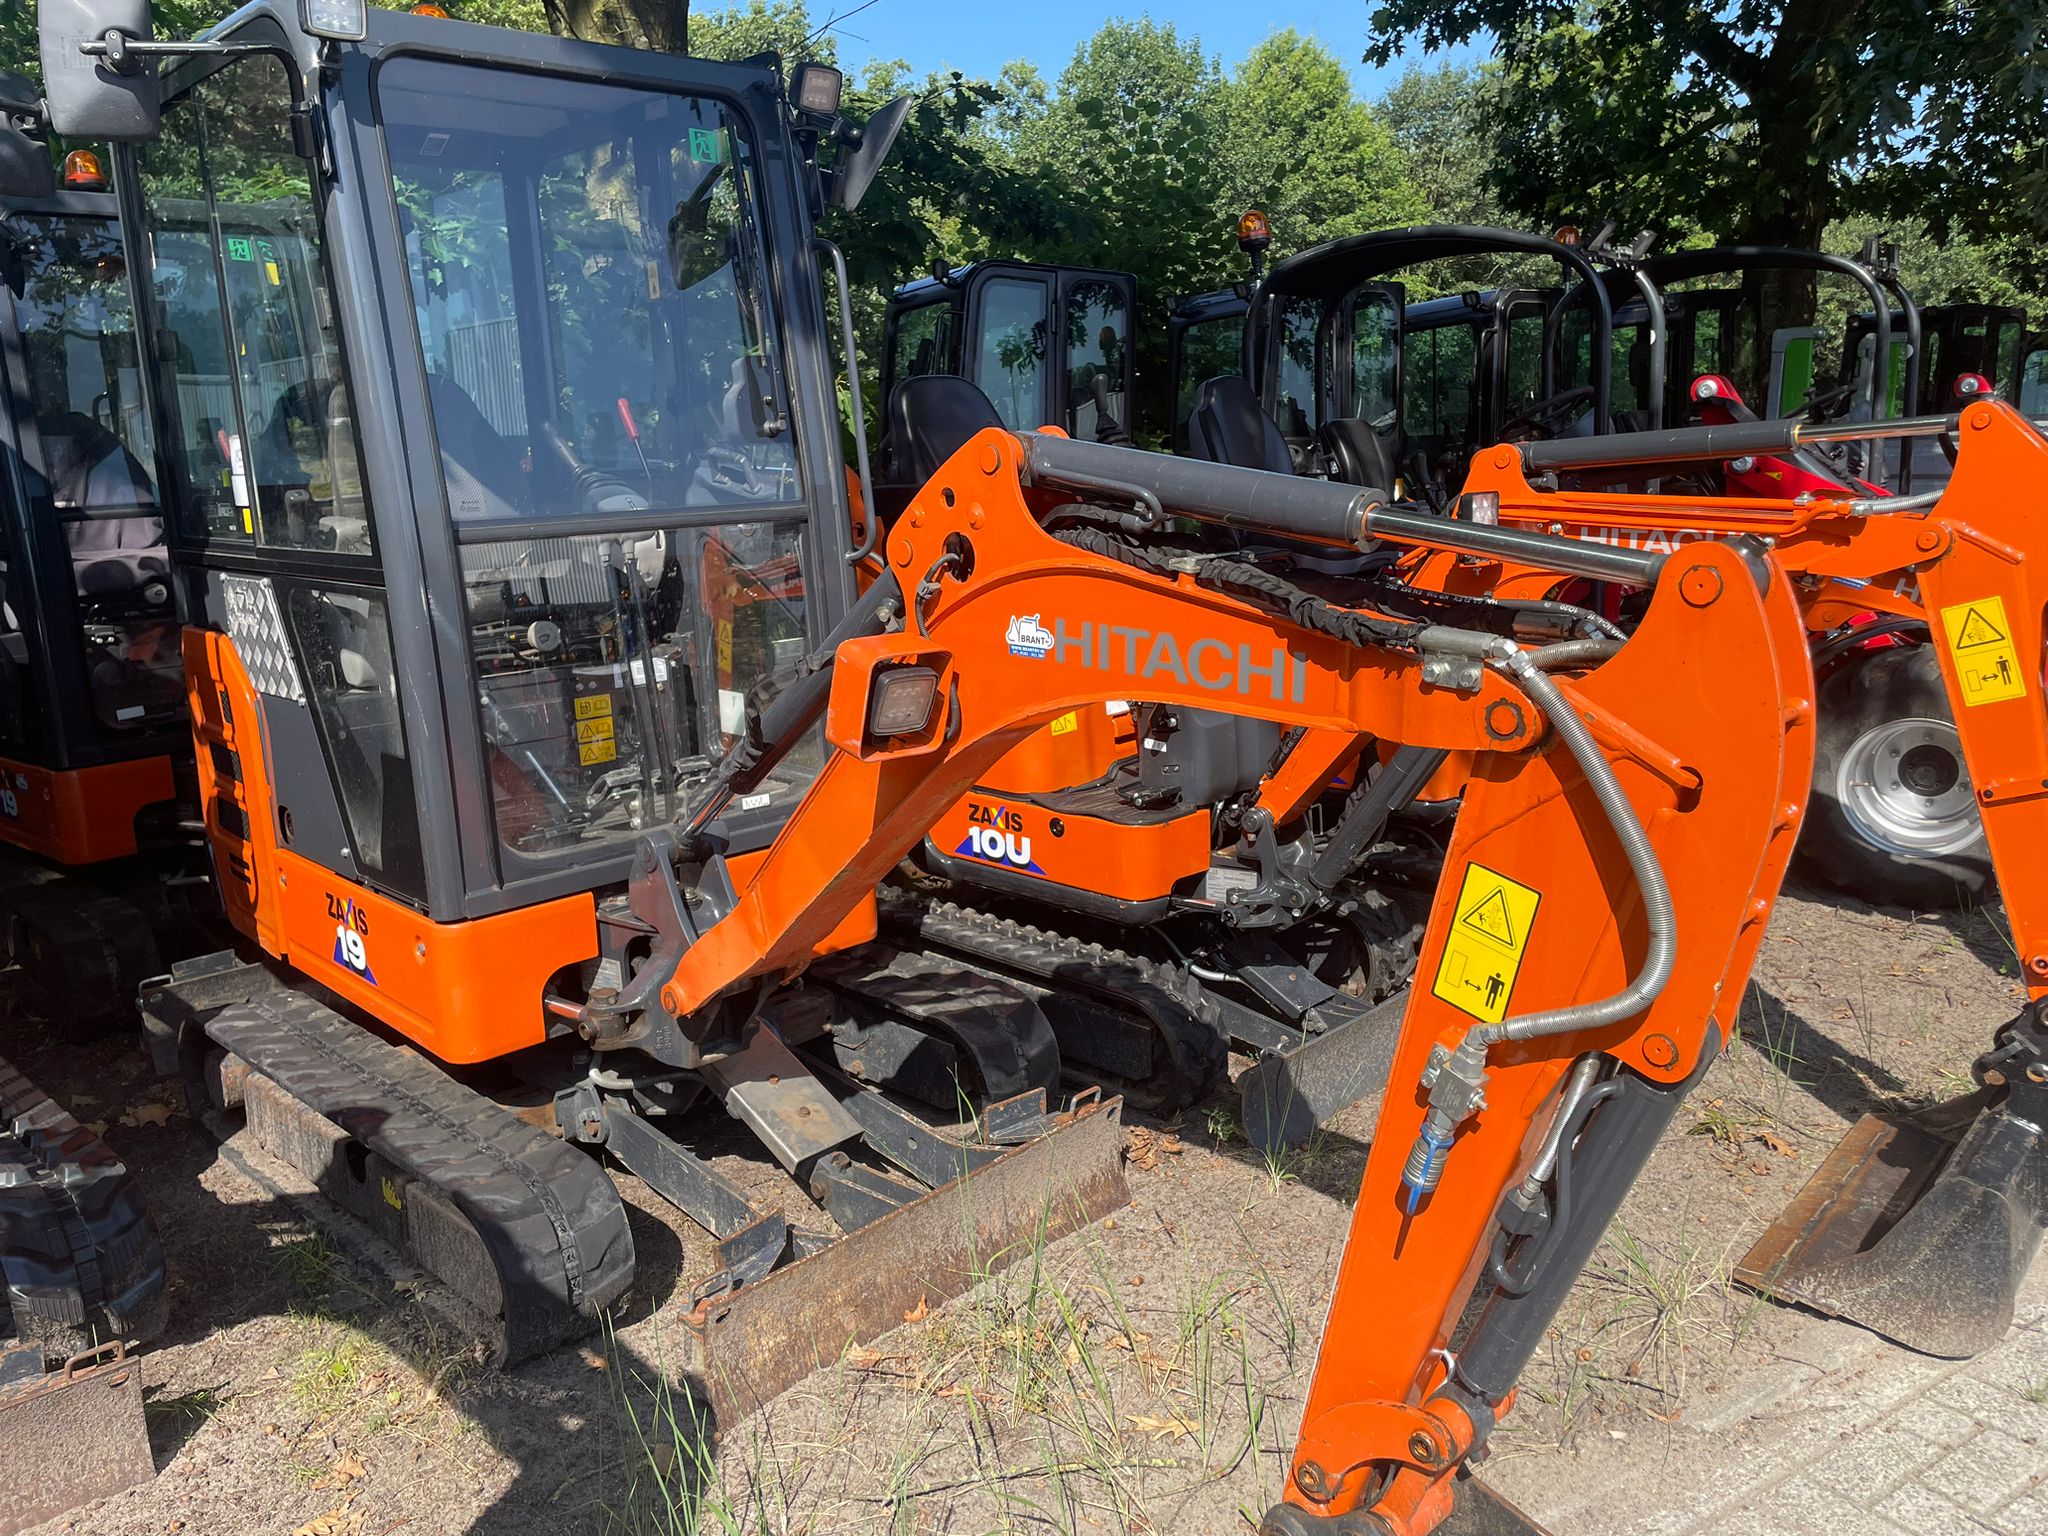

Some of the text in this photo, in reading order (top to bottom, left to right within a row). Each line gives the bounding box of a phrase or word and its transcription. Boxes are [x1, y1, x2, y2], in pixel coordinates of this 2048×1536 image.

[1580, 527, 1746, 555] HITAC
[1021, 634, 1046, 645] BRANT
[1055, 617, 1306, 704] HITACHI
[0, 789, 17, 816] 19
[968, 803, 1023, 832] ZAXIS
[968, 826, 1031, 868] 10U
[325, 891, 369, 936] ZAXIS
[336, 924, 368, 973] 19
